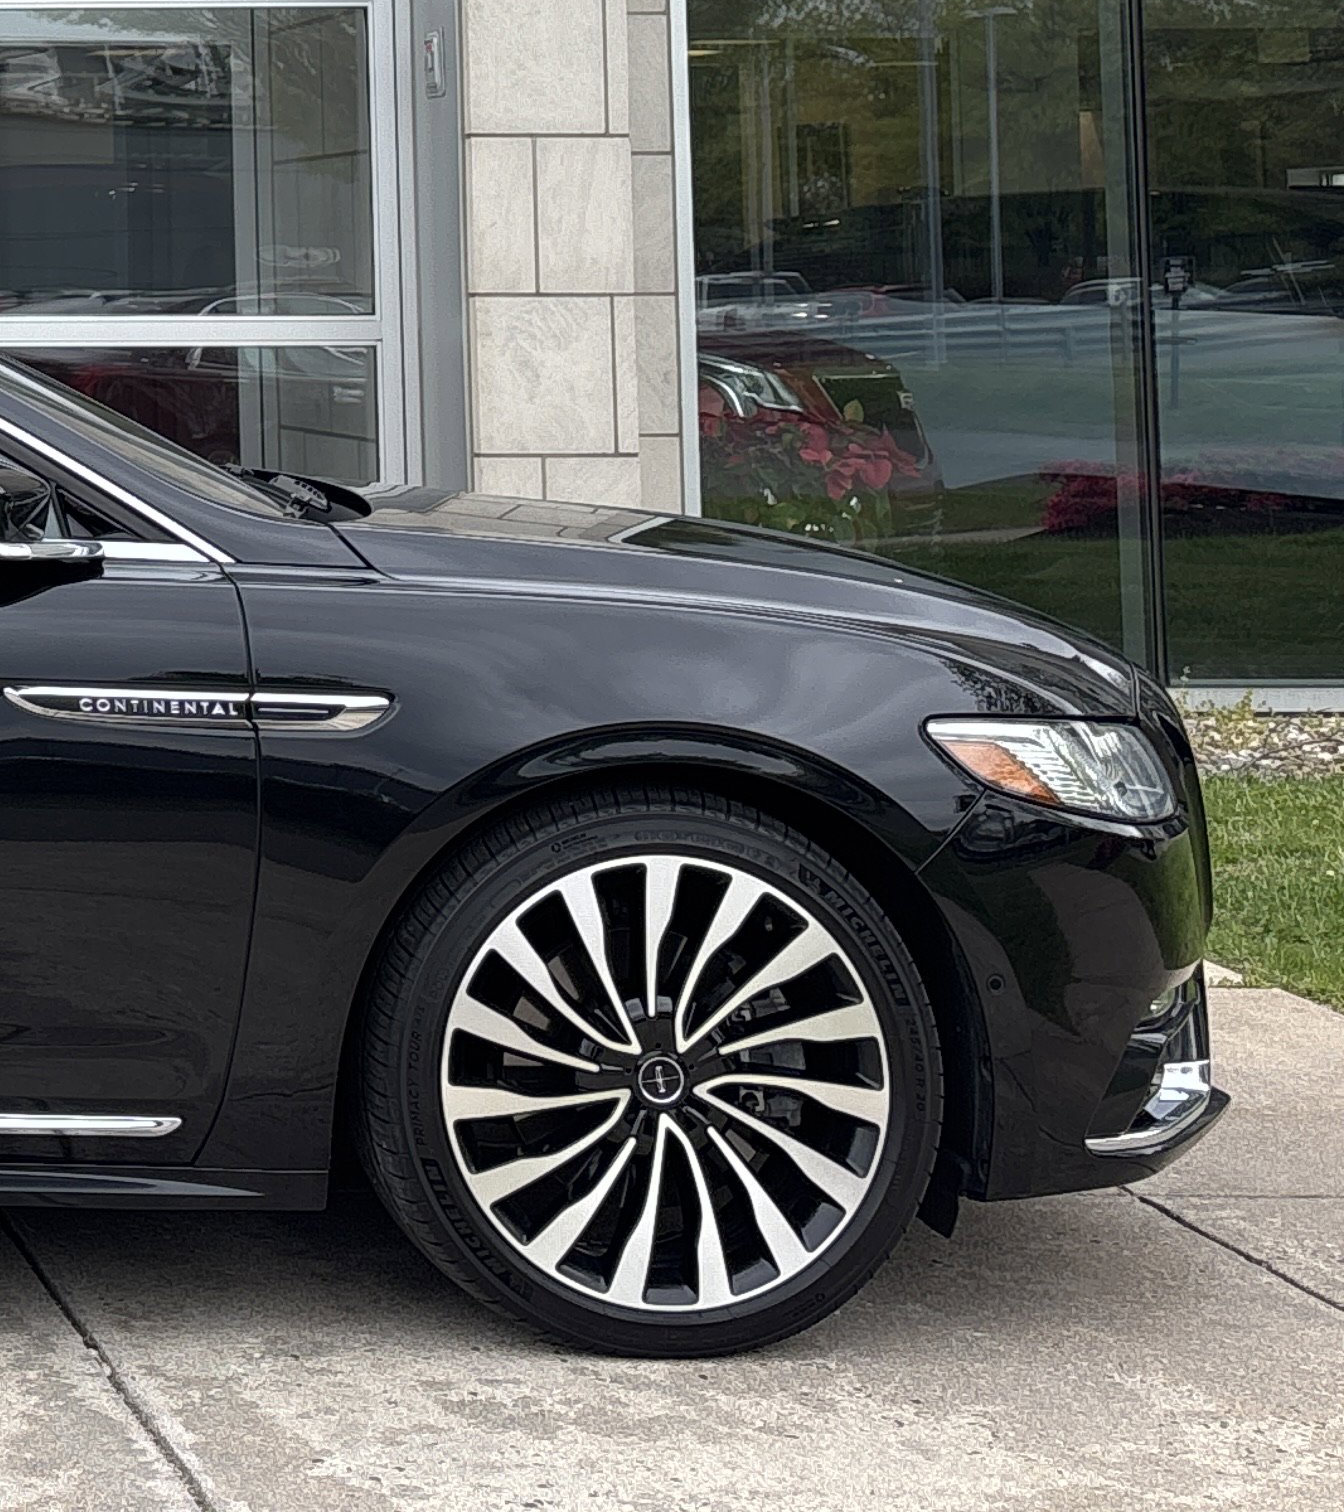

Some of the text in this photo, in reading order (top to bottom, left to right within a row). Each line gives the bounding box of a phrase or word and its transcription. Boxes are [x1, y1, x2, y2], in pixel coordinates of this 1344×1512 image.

[78, 697, 239, 716] CONTINENTAL
[823, 891, 907, 999] MICHELIN
[408, 1031, 422, 1072] TOUR
[408, 1080, 426, 1147] PRIMACY
[424, 1164, 507, 1275] MICHELIN
